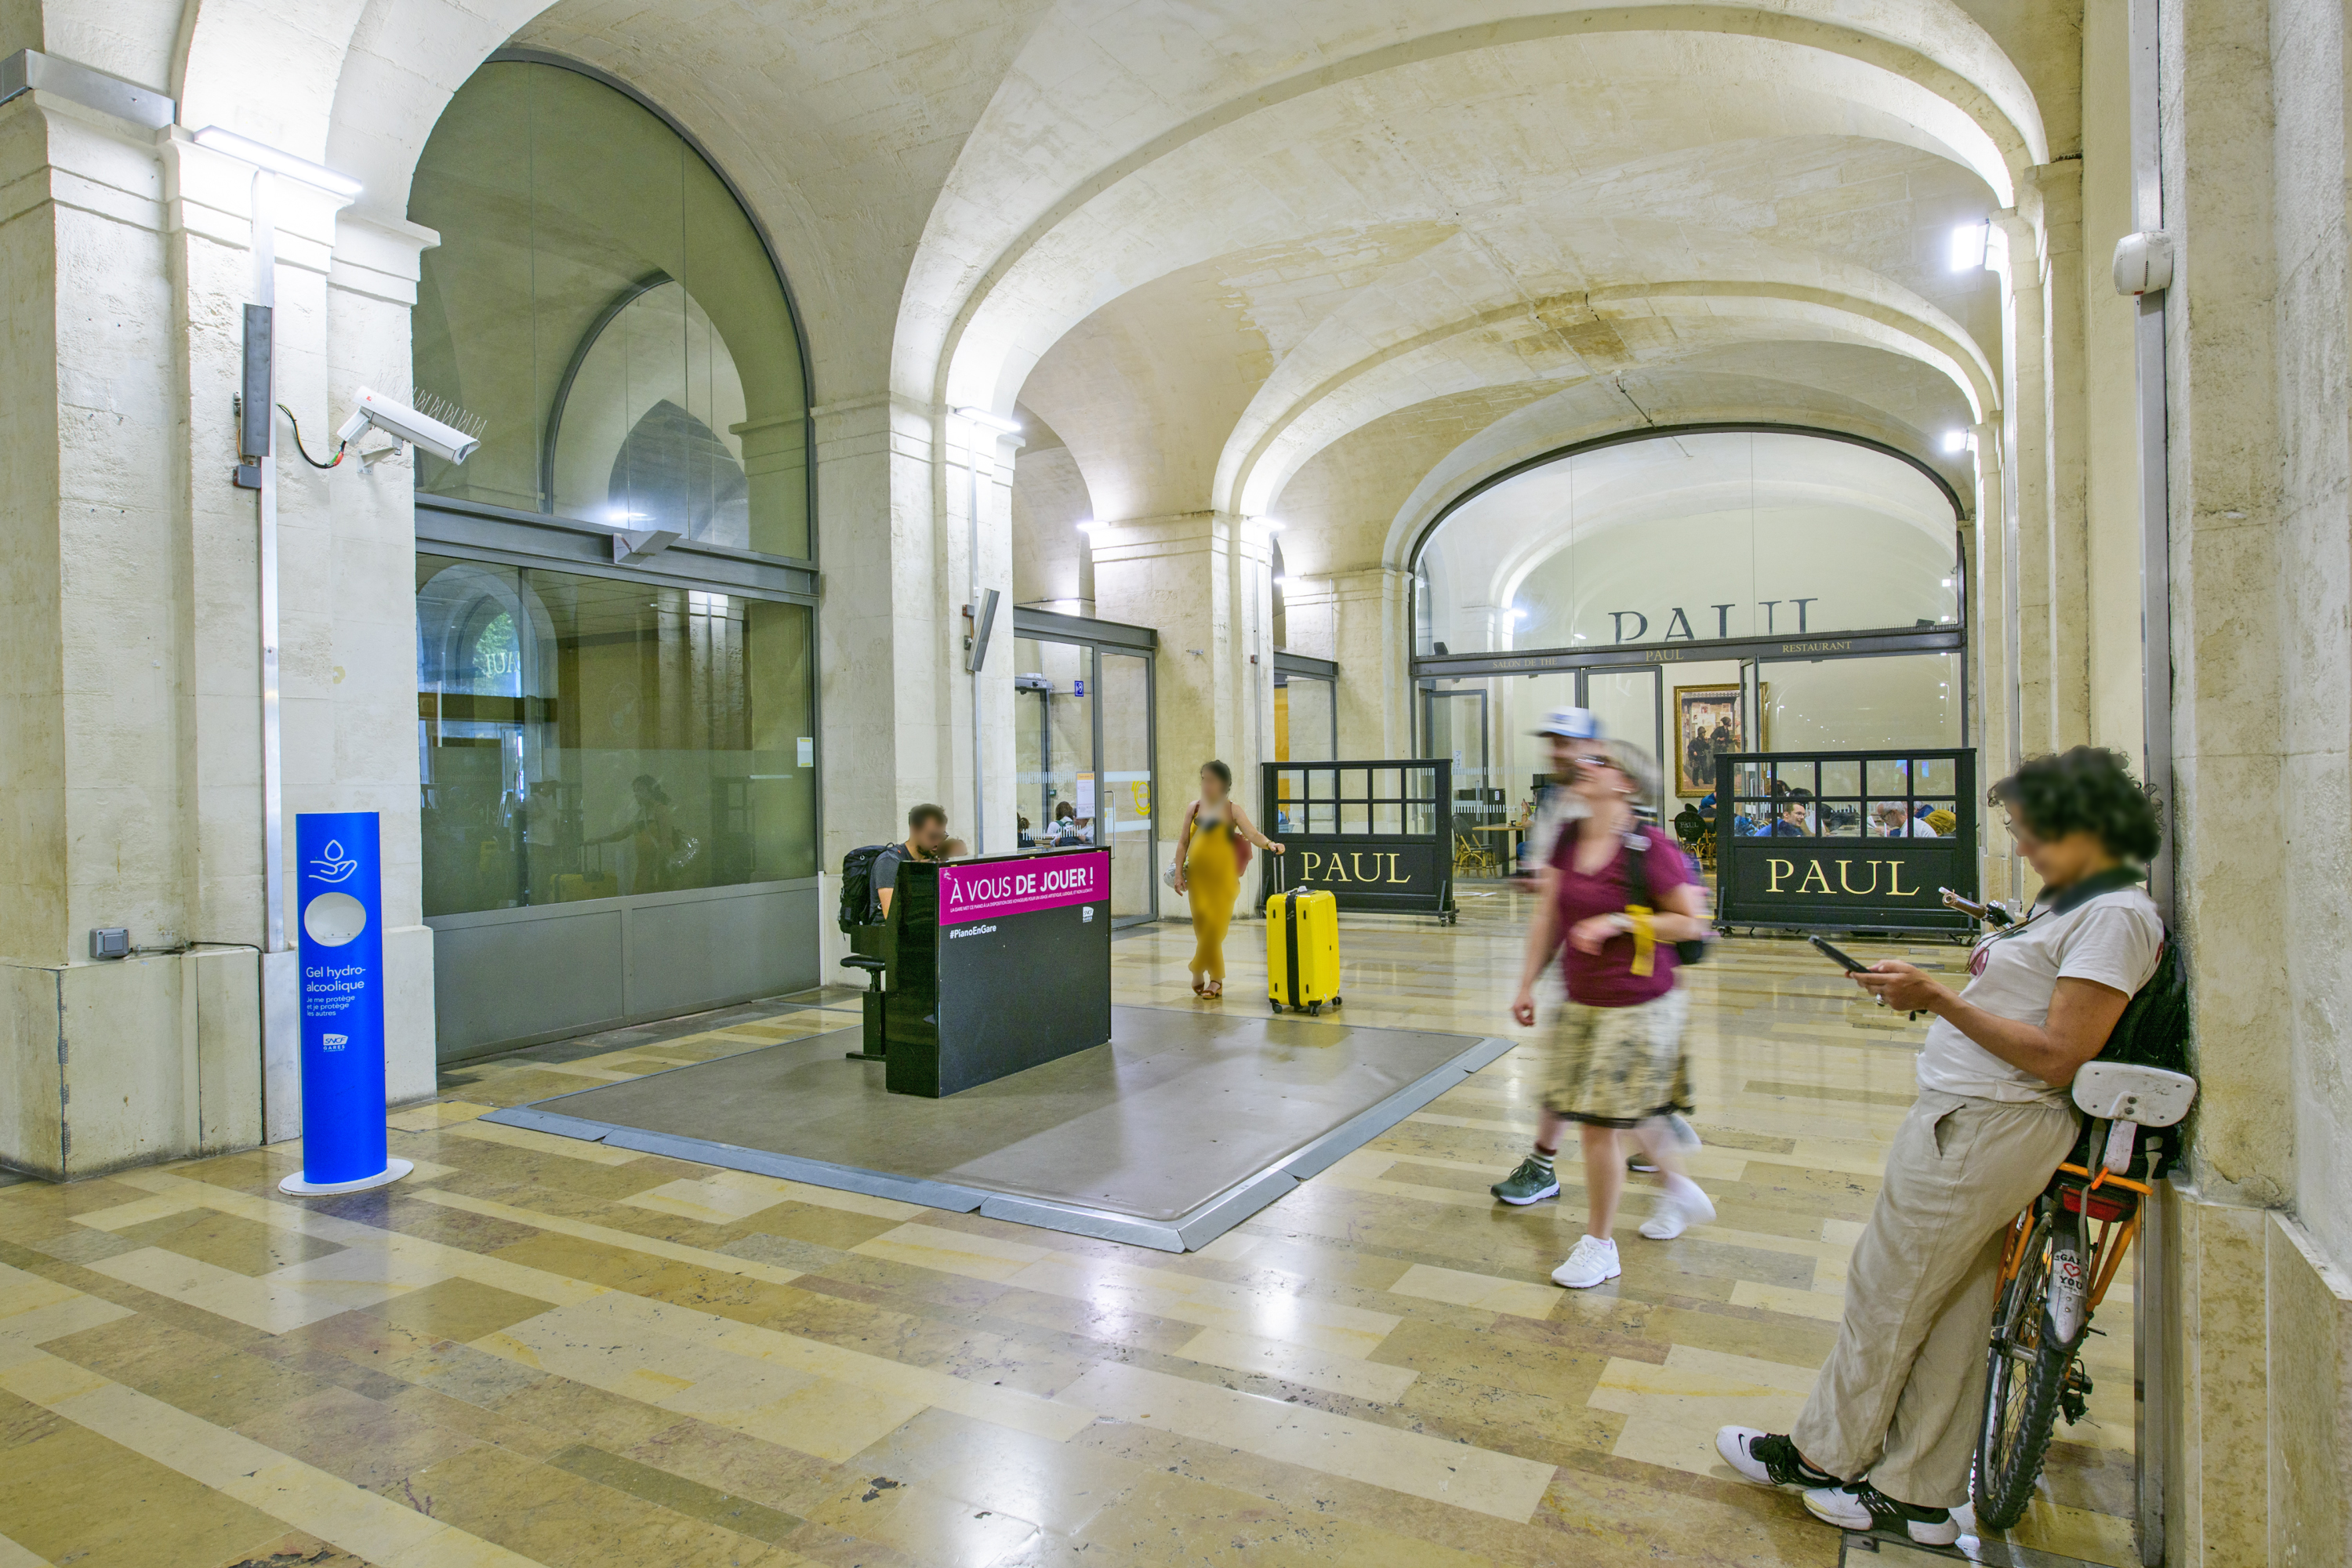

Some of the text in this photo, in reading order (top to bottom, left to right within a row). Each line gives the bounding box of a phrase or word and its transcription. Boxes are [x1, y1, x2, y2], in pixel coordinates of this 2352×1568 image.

[1782, 641, 1852, 654] RESTAURANT
[1646, 649, 1684, 662] PAUL
[1493, 657, 1558, 668] SALON DE THE
[1300, 851, 1411, 884] PAUL
[1766, 858, 1920, 896] PAUL
[949, 878, 964, 904] À
[967, 876, 1011, 902] VOUS
[1016, 873, 1036, 895] DE
[1040, 868, 1086, 892] JOUER
[949, 924, 996, 939] #PianoEnGare
[306, 964, 366, 979] Gel hydro-
[307, 980, 365, 993] alcoolique
[325, 995, 355, 1004] protège
[320, 1002, 349, 1011] protège
[2060, 1276, 2083, 1290] YOU
